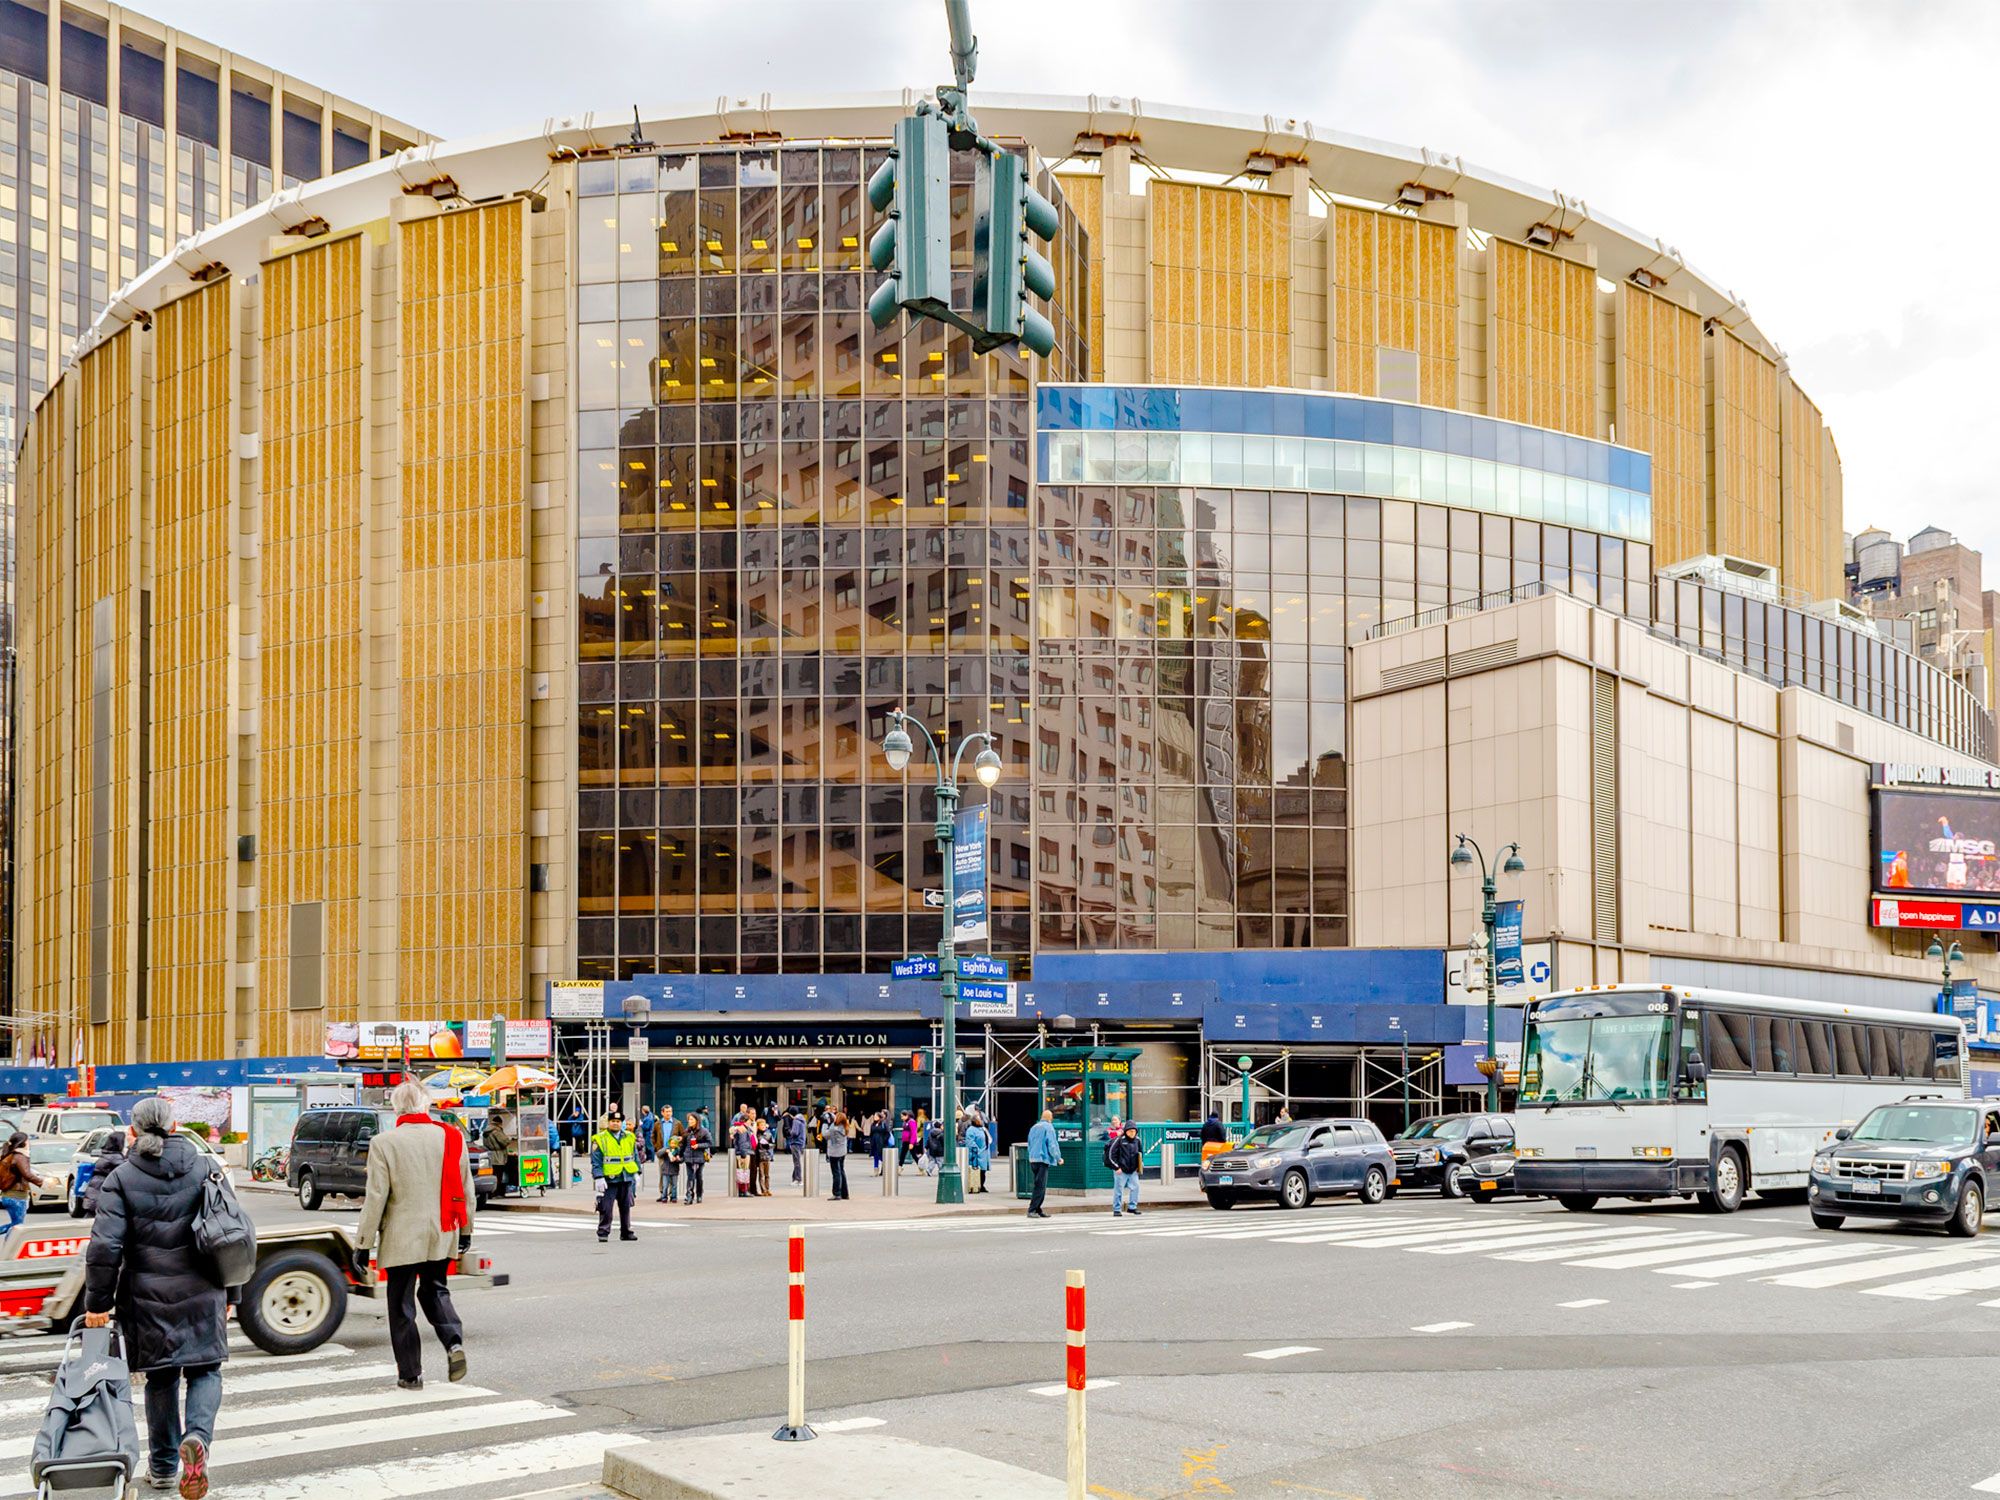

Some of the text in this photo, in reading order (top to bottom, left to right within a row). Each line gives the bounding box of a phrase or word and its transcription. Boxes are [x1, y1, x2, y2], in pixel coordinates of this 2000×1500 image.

[1886, 763, 1942, 786] MADISON
[1942, 767, 1989, 787] SQUARE
[1946, 839, 1996, 855] MSG
[1900, 911, 1918, 921] open
[1919, 913, 1955, 922] happiness
[895, 962, 936, 976] West 33rd St
[962, 961, 1003, 975] Eighth Ave
[963, 987, 974, 997] Joe
[975, 988, 992, 998] Louis
[1648, 1003, 1669, 1012] 006
[1530, 1011, 1546, 1020] 006
[675, 1034, 888, 1046] PENNSYLVANIA STATION
[1110, 1062, 1124, 1071] TAXI
[1166, 1130, 1190, 1140] Subway
